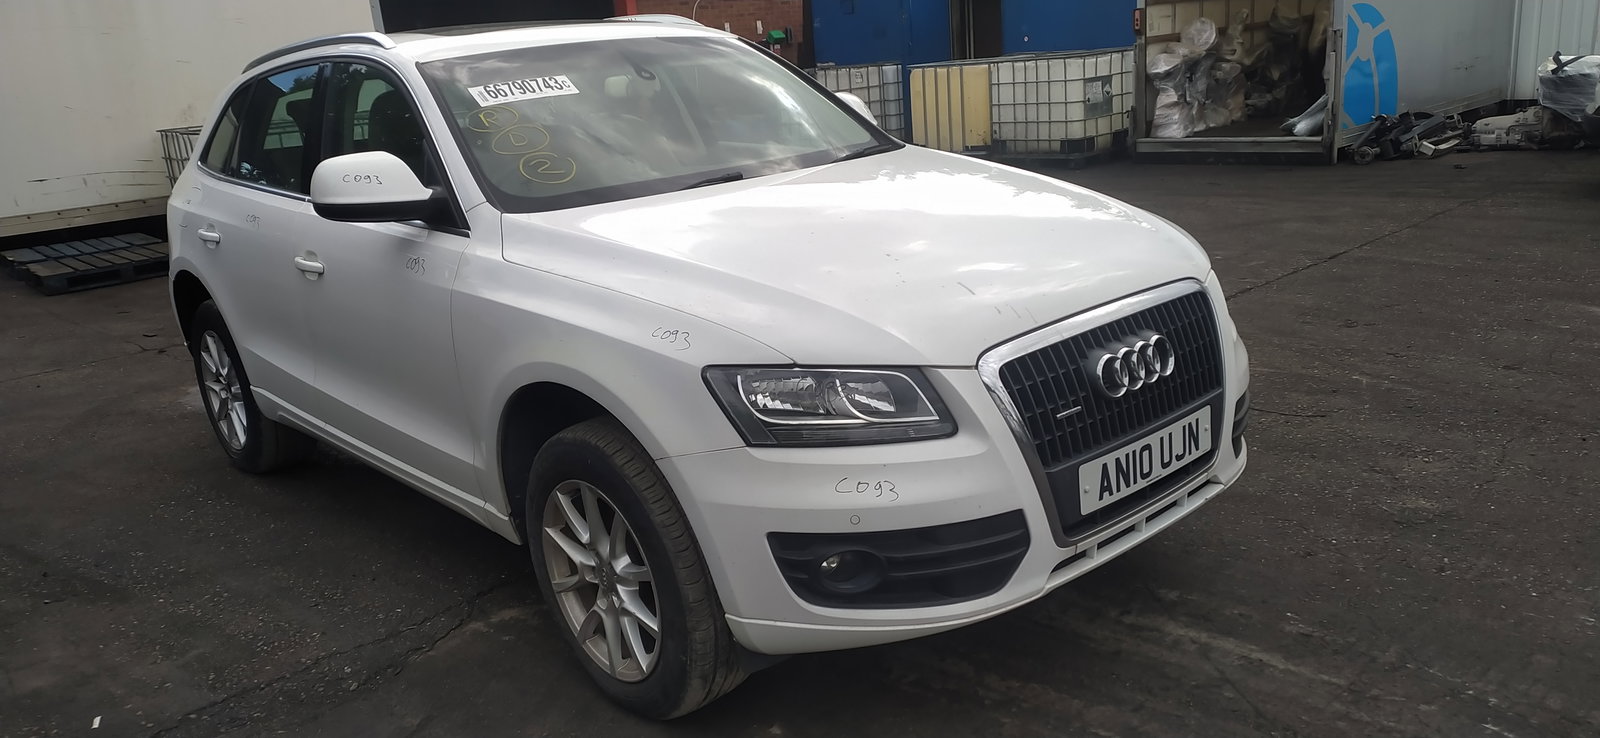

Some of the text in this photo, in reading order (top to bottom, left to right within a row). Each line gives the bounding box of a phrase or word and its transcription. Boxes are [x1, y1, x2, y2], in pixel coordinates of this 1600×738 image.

[479, 110, 498, 127] R
[529, 158, 566, 174] 2
[651, 326, 691, 351] C093
[1098, 417, 1200, 501] AN10 UJN
[834, 477, 899, 502] C093
